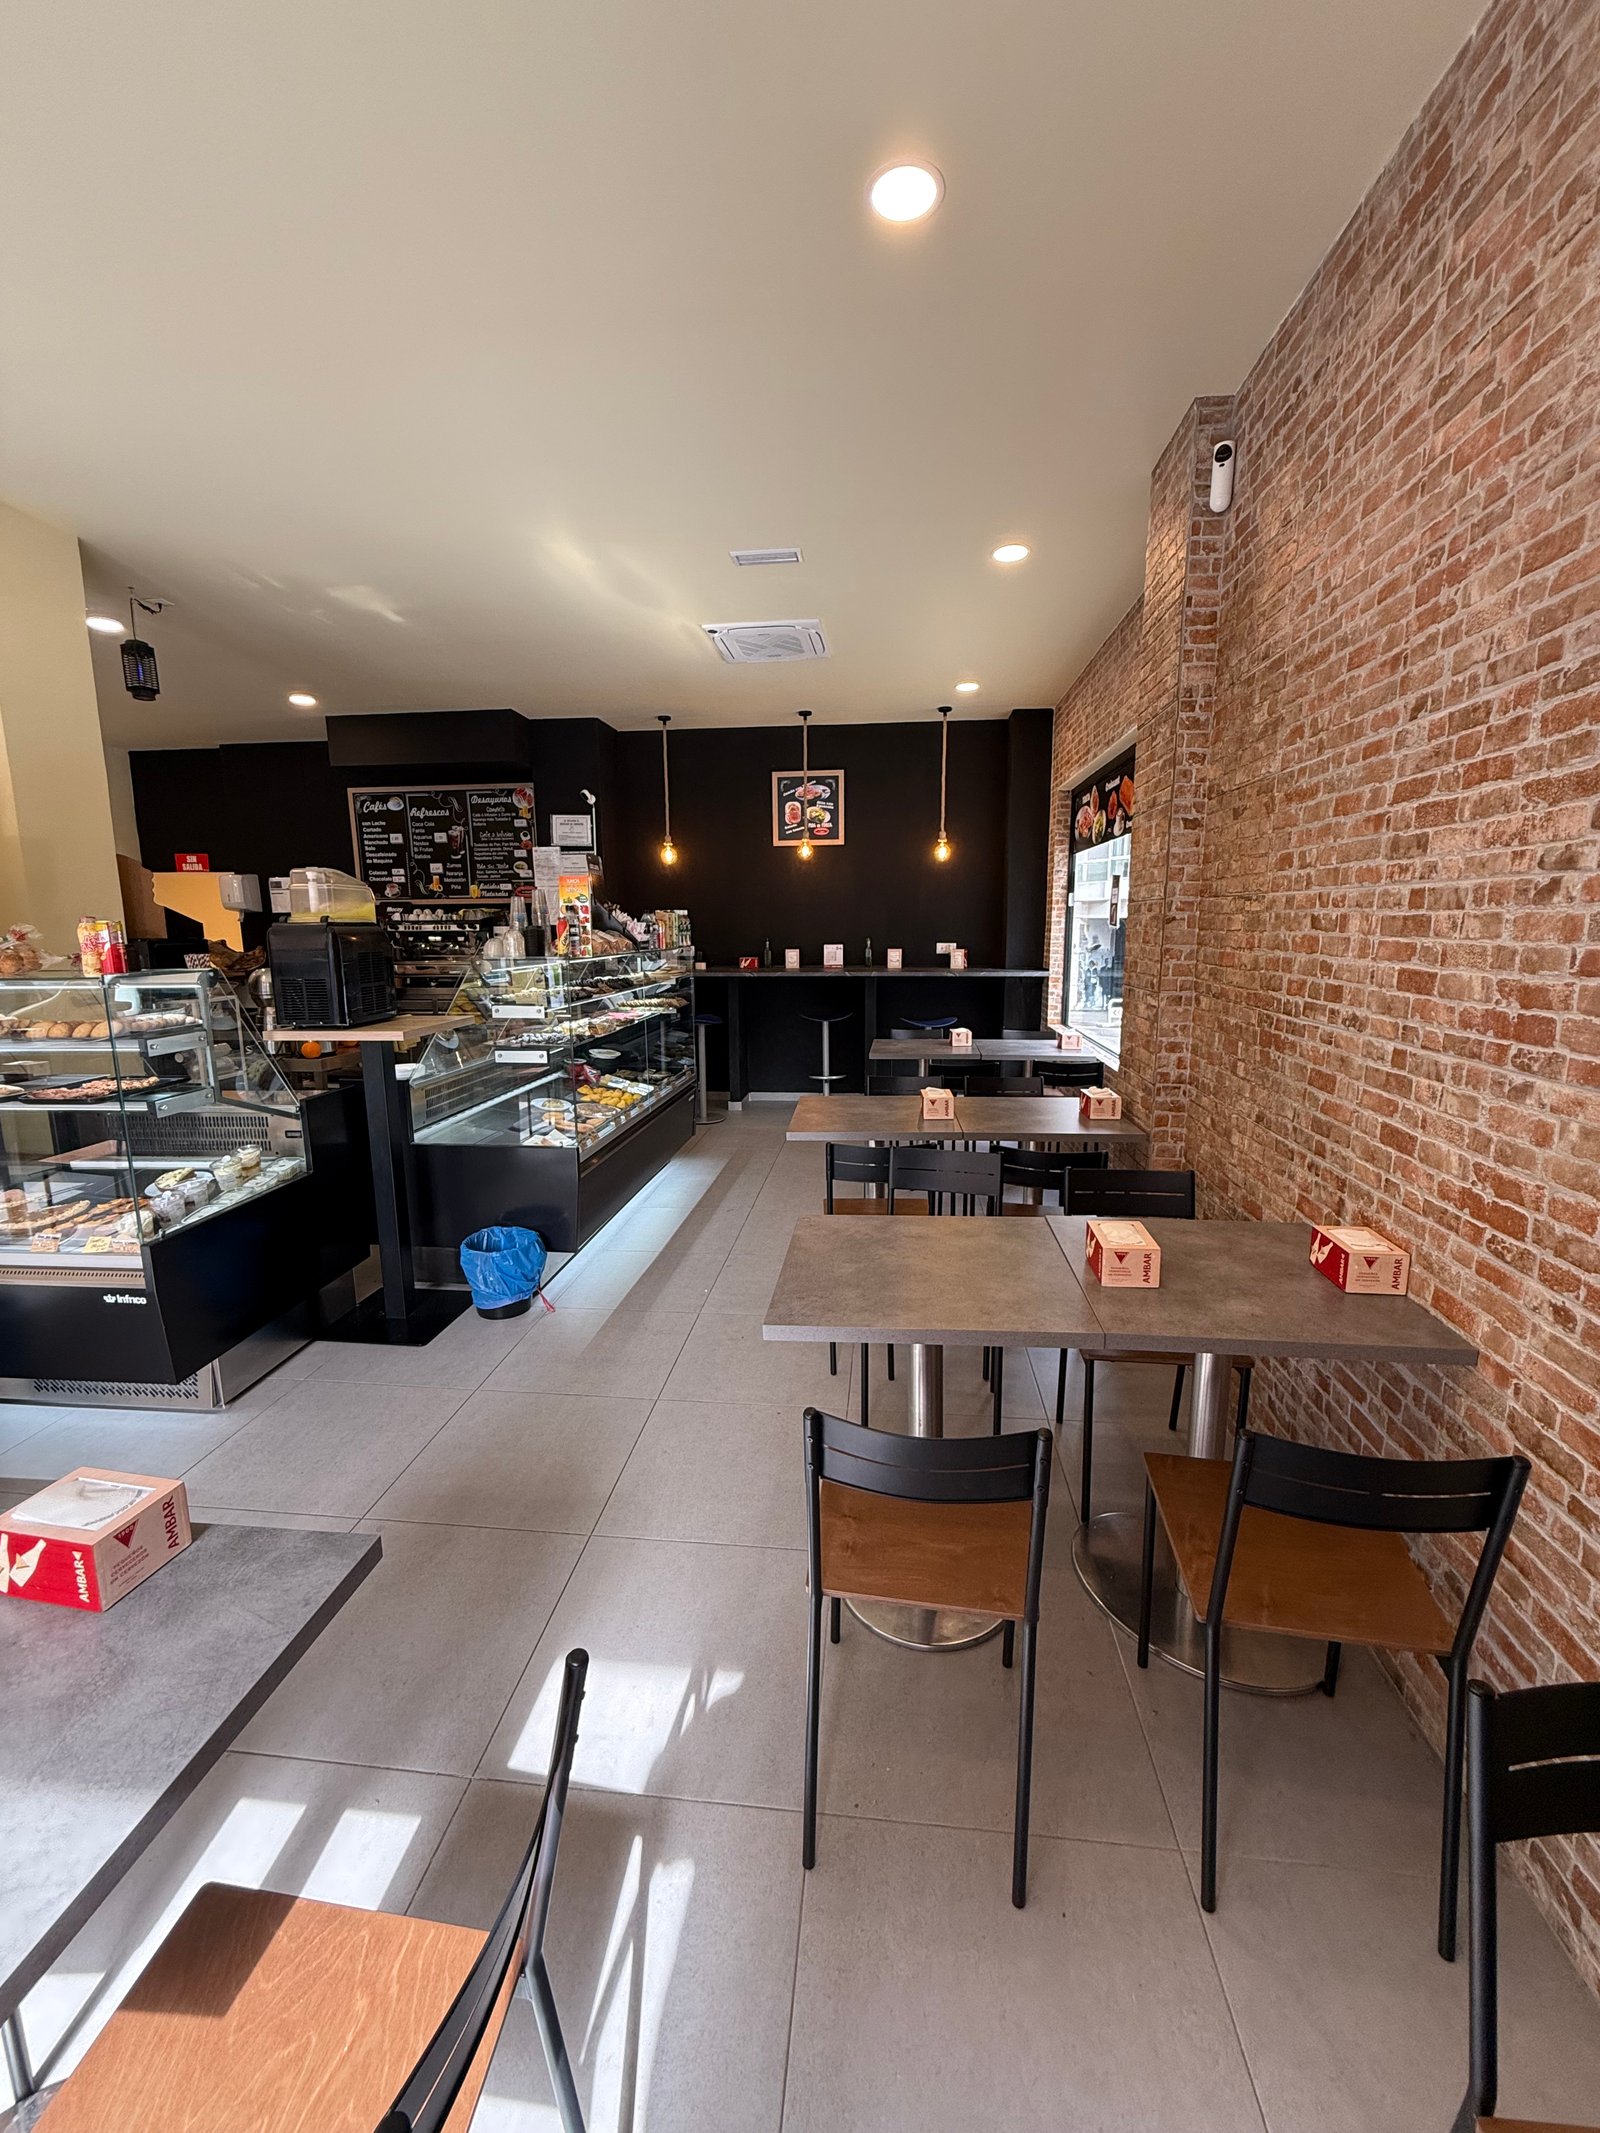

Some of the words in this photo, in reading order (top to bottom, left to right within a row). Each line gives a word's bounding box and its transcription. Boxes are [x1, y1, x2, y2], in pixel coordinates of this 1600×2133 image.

[363, 801, 387, 813] Cafés
[410, 808, 449, 818] Refrescos
[1142, 1252, 1152, 1284] AMBAR
[1392, 1258, 1403, 1290] AMBAR
[162, 1495, 180, 1550] AMBAR
[73, 1559, 90, 1603] AMBAR
